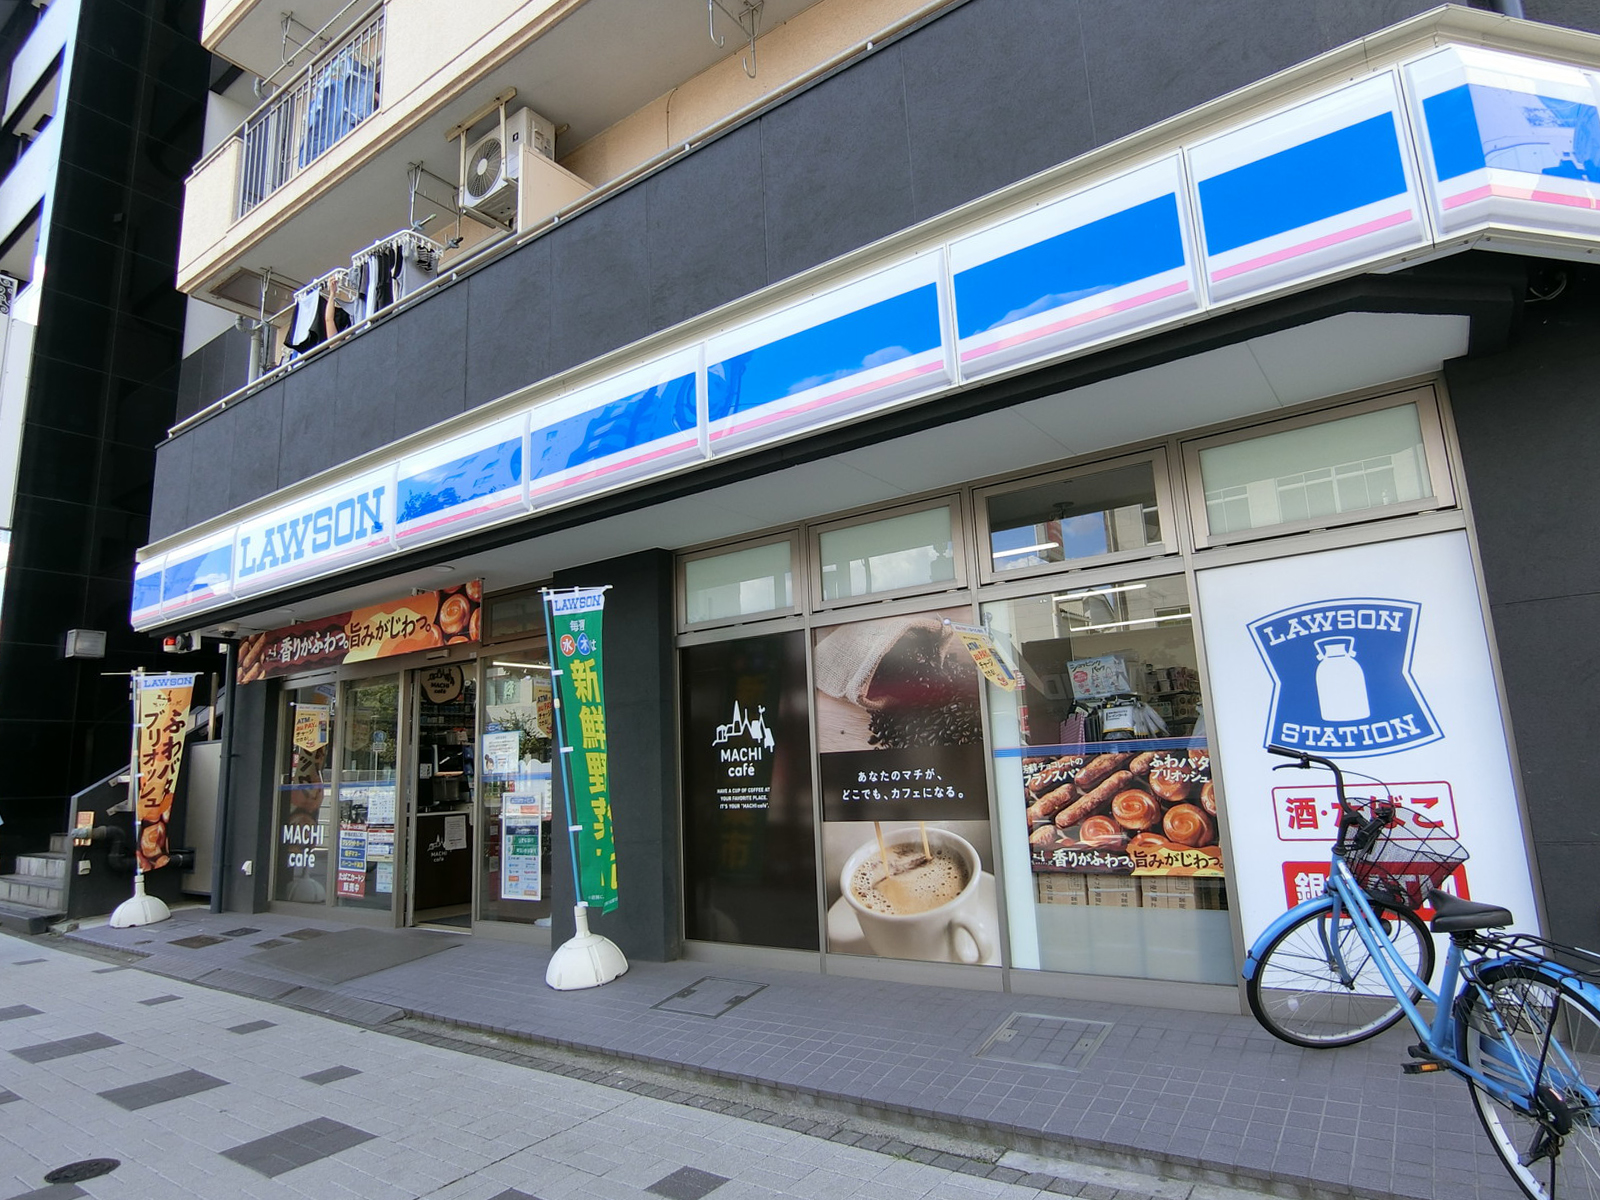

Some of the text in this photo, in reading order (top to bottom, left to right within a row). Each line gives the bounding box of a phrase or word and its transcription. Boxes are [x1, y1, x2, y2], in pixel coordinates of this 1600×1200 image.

[239, 486, 385, 578] LAWSON
[555, 595, 601, 611] LAWSON
[1263, 609, 1403, 646] LAWSON
[280, 631, 349, 663] 香りがふわっ。
[350, 615, 432, 650] 旨みがじわっ。
[143, 676, 193, 688] LAWSON
[1281, 713, 1421, 747] STATION
[720, 747, 762, 762] MACHI
[1149, 755, 1211, 770] ふわバタ
[728, 763, 755, 777] café
[857, 768, 943, 783] あなたのマチが、
[1023, 768, 1087, 787] フランスパン
[1150, 769, 1210, 784] ブリオッシュ
[842, 786, 965, 801] どこでも、カフェになる。
[283, 824, 324, 846] MACHI
[288, 848, 316, 868] café
[1052, 849, 1134, 868] 香りがふわっ。
[1134, 850, 1224, 869] 旨みがじわっ。
